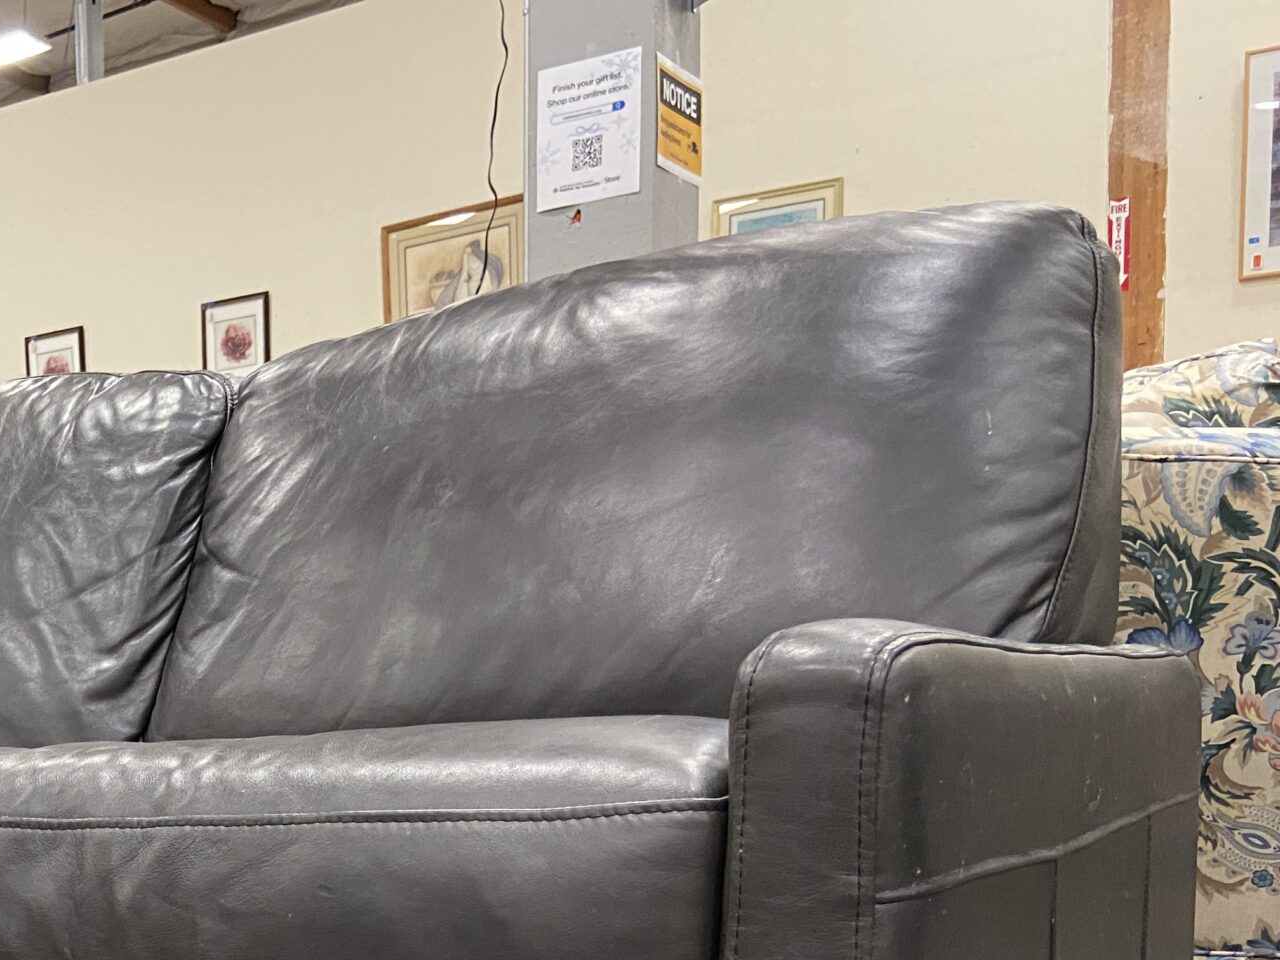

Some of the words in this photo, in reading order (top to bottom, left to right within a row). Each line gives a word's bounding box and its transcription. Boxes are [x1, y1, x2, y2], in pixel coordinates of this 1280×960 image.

[552, 83, 575, 94] Finish
[577, 79, 594, 89] your
[596, 73, 609, 85] gift
[546, 97, 568, 108] Shop
[568, 95, 582, 103] our
[582, 89, 607, 101] online
[608, 83, 630, 94] store.
[663, 78, 697, 118] NOTICE
[1111, 203, 1127, 214] FIRE
